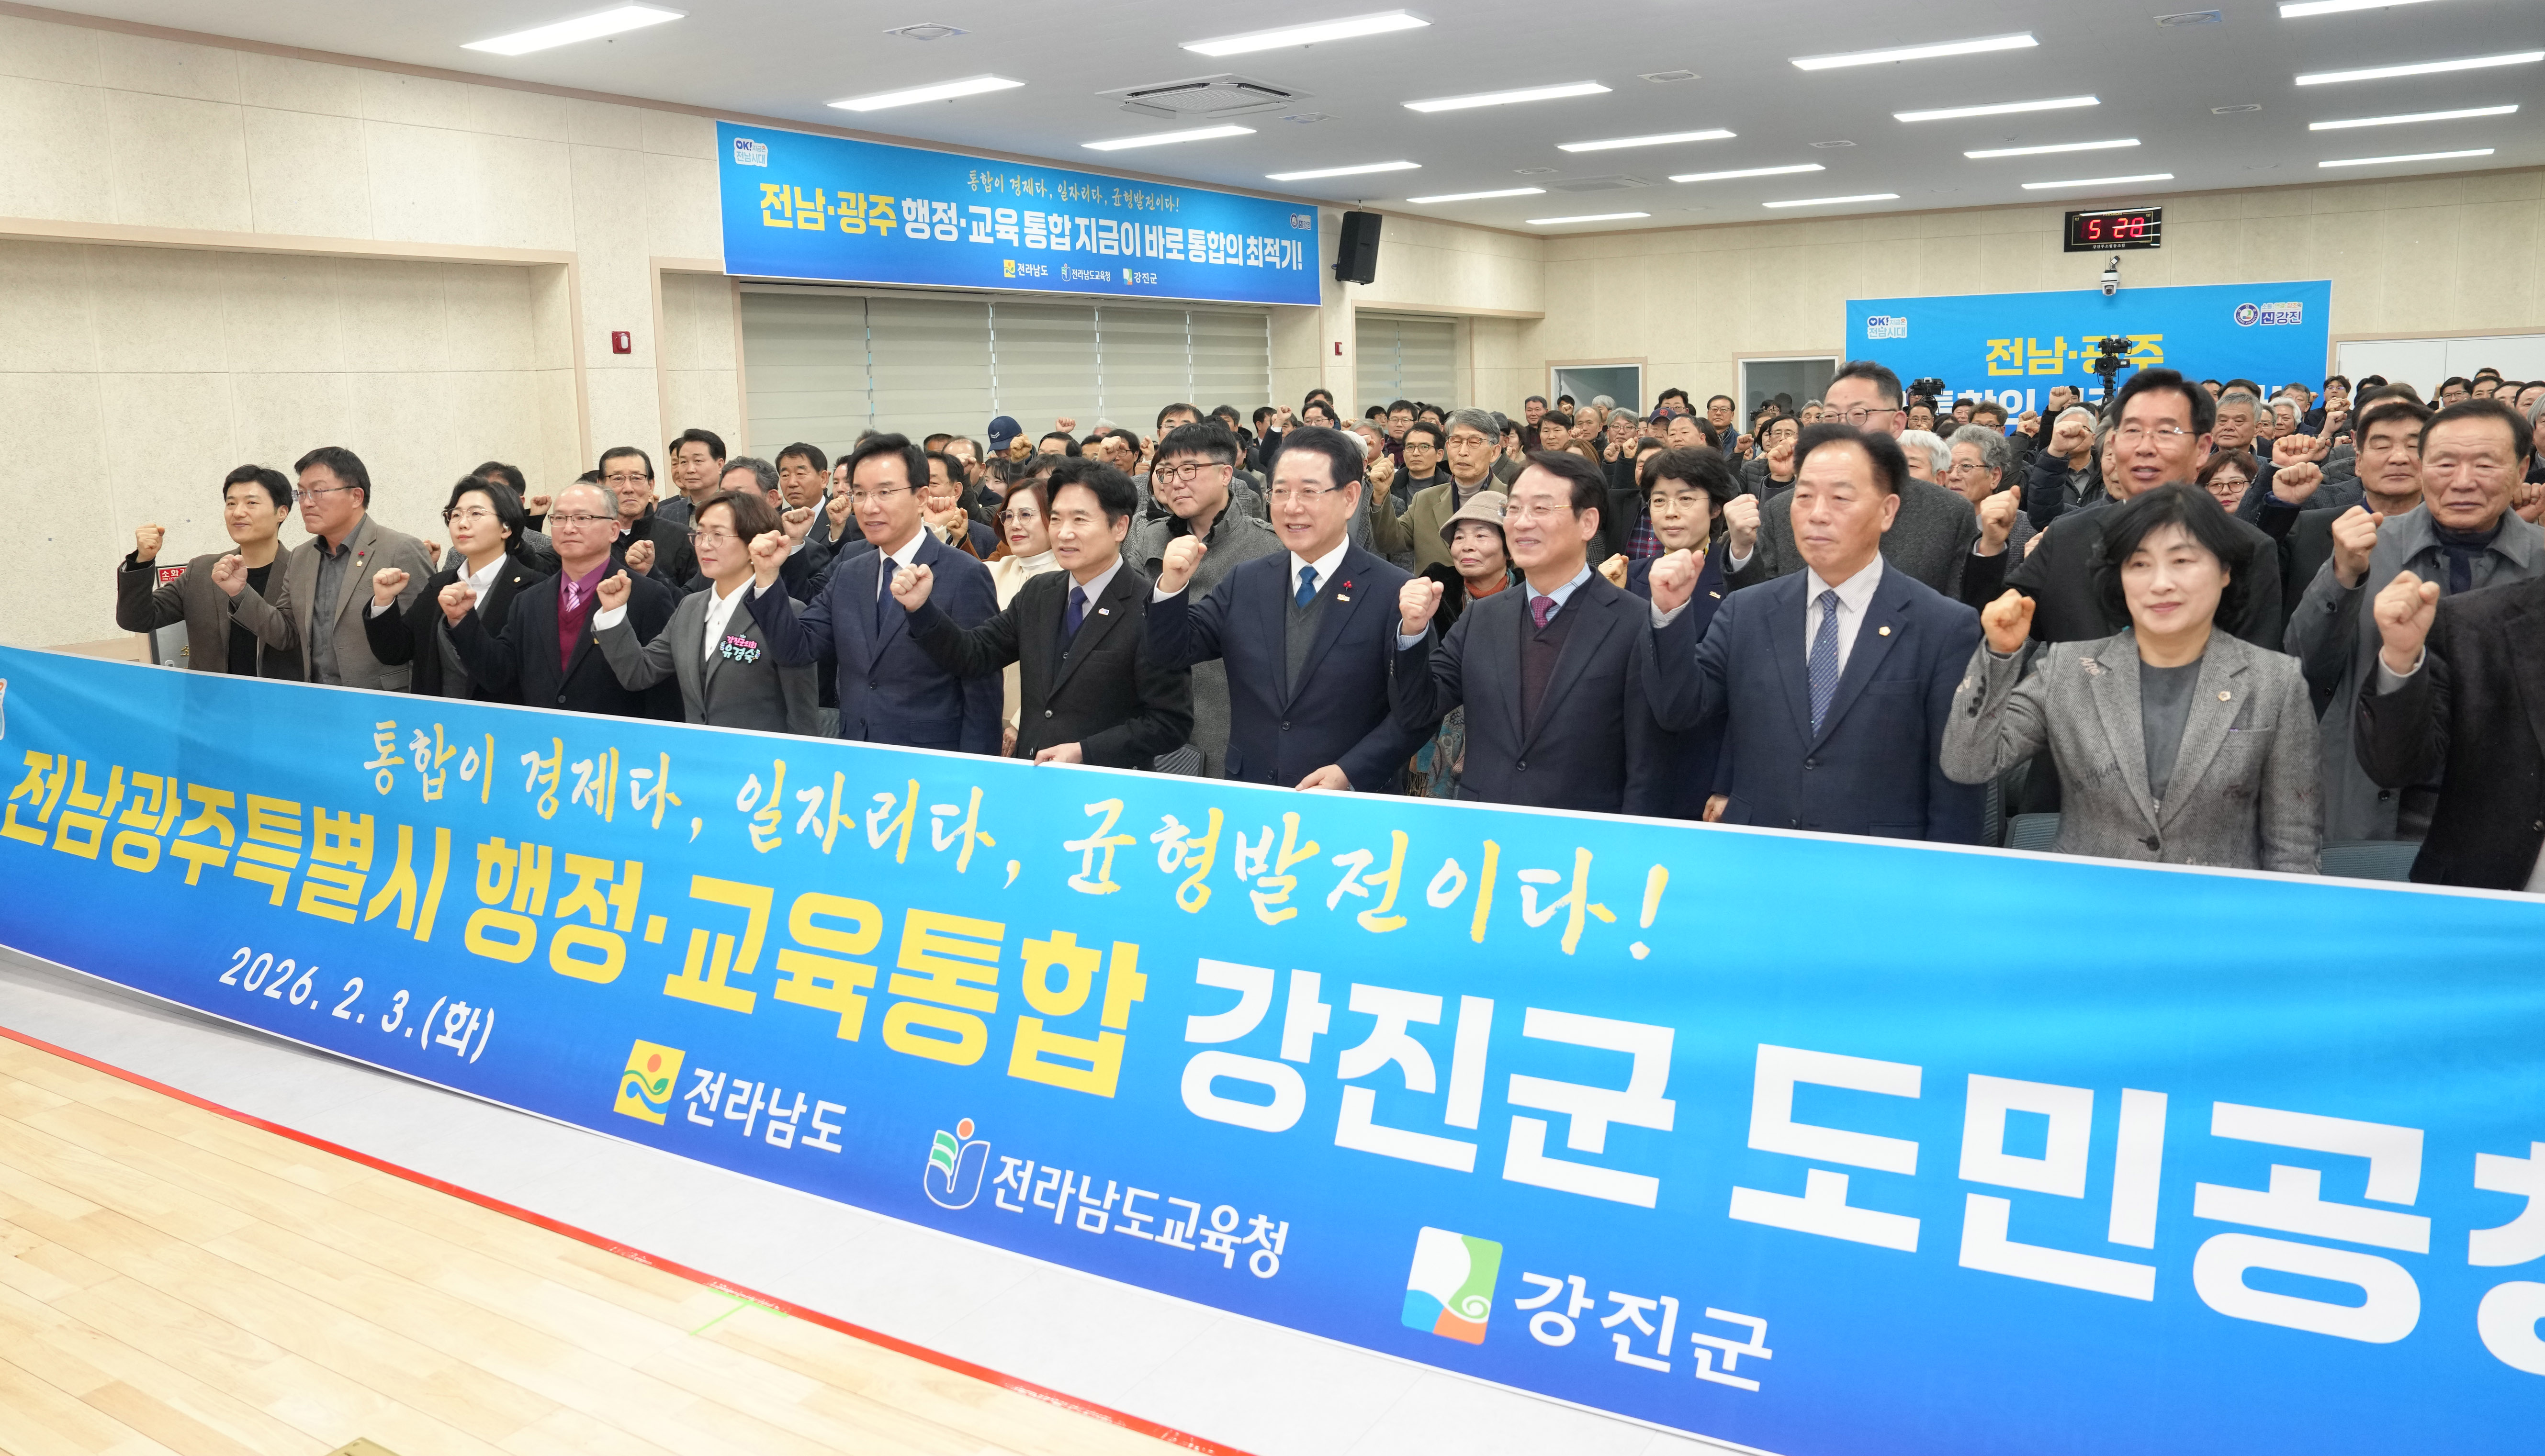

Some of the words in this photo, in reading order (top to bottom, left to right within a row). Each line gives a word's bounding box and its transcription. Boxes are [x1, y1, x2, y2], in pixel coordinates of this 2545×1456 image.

[736, 140, 752, 151] OK!
[736, 151, 766, 164] 전남시대
[968, 170, 1003, 192] 통합이
[1010, 175, 1052, 199] 경제다,
[1058, 181, 1107, 204] 일자리다,
[1113, 189, 1179, 212] 균형발전이다!
[760, 183, 897, 236] 전남·광주
[902, 198, 1019, 246] 행정·교육
[1024, 211, 1071, 251] 통합
[1075, 217, 1140, 257] 지금이
[1145, 225, 1184, 260] 바로
[1188, 229, 1243, 266] 통합의
[1247, 236, 1302, 270] 최적기!
[1017, 263, 1048, 277] 전라남도
[1072, 269, 1110, 281] 전라남도교육청
[1134, 272, 1157, 284] 강진군
[1869, 317, 1889, 326] OK!
[2262, 311, 2301, 325] 신강진
[1869, 326, 1905, 337] 전남시대
[727, 636, 757, 649] 강진군의회
[722, 644, 754, 663] 유경숙
[364, 720, 494, 804] 통합이
[521, 738, 702, 843] 경제다,
[737, 759, 1021, 889] 일자리다,
[1063, 799, 1669, 960] 균형발전이다!
[1, 750, 450, 942] 전남광주특별시
[465, 837, 1147, 1098] 행정·교육통합
[1181, 958, 1676, 1208] 강진군
[219, 947, 318, 1009] 2026.
[332, 977, 364, 1023] 2.
[685, 1068, 846, 1153] 전라남도
[993, 1156, 1289, 1278] 전라남도교육청
[1515, 1272, 1772, 1391] 강진군
